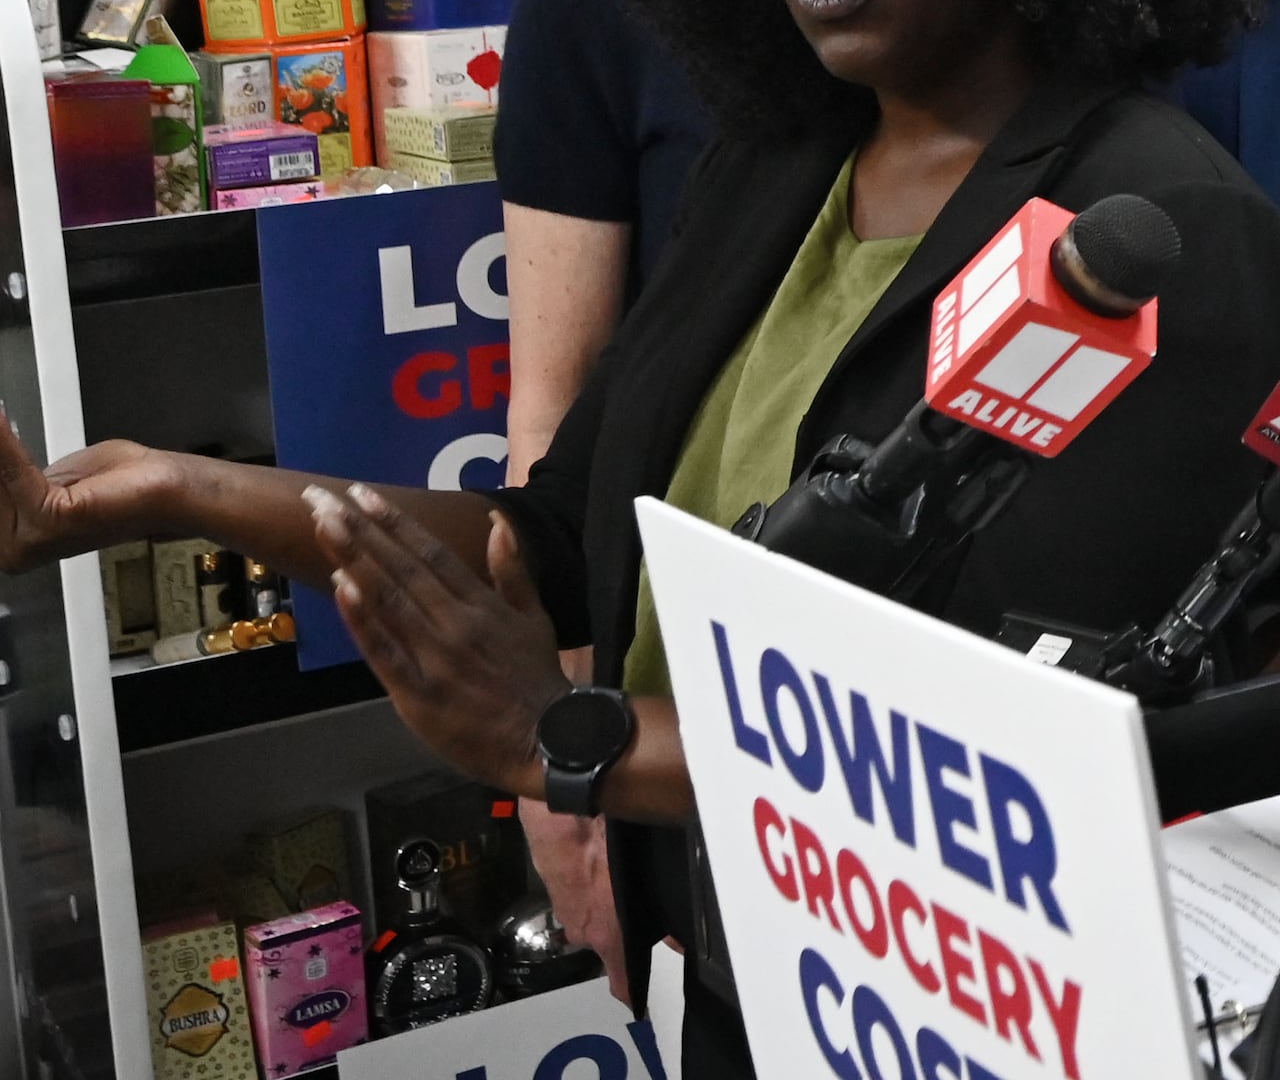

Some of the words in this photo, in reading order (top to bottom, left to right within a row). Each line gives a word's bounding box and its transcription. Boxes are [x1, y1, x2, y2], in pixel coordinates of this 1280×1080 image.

[229, 100, 266, 118] LORD
[931, 290, 958, 385] ALIVE
[948, 389, 1063, 447] ALIVE
[710, 619, 1073, 938] LOWER
[753, 796, 1083, 1080] GROCERY
[168, 1006, 221, 1034] BUSHRA
[295, 999, 341, 1022] LAMSA
